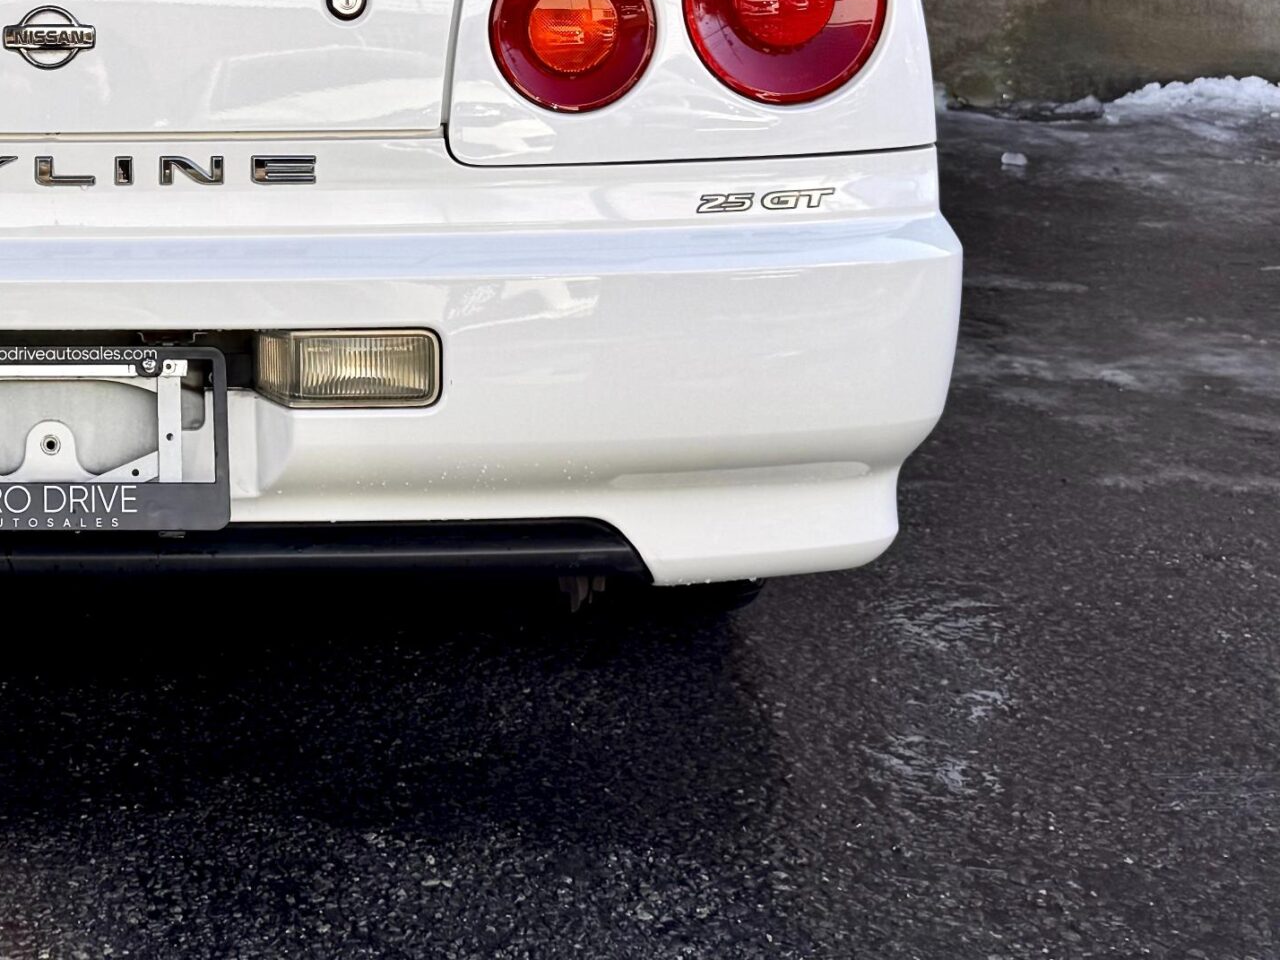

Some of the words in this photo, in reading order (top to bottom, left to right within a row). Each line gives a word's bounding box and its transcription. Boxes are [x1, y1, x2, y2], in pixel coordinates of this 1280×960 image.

[14, 30, 84, 45] NISSAN
[696, 192, 755, 214] 25
[761, 187, 836, 210] GT
[44, 485, 138, 514] DRIVE
